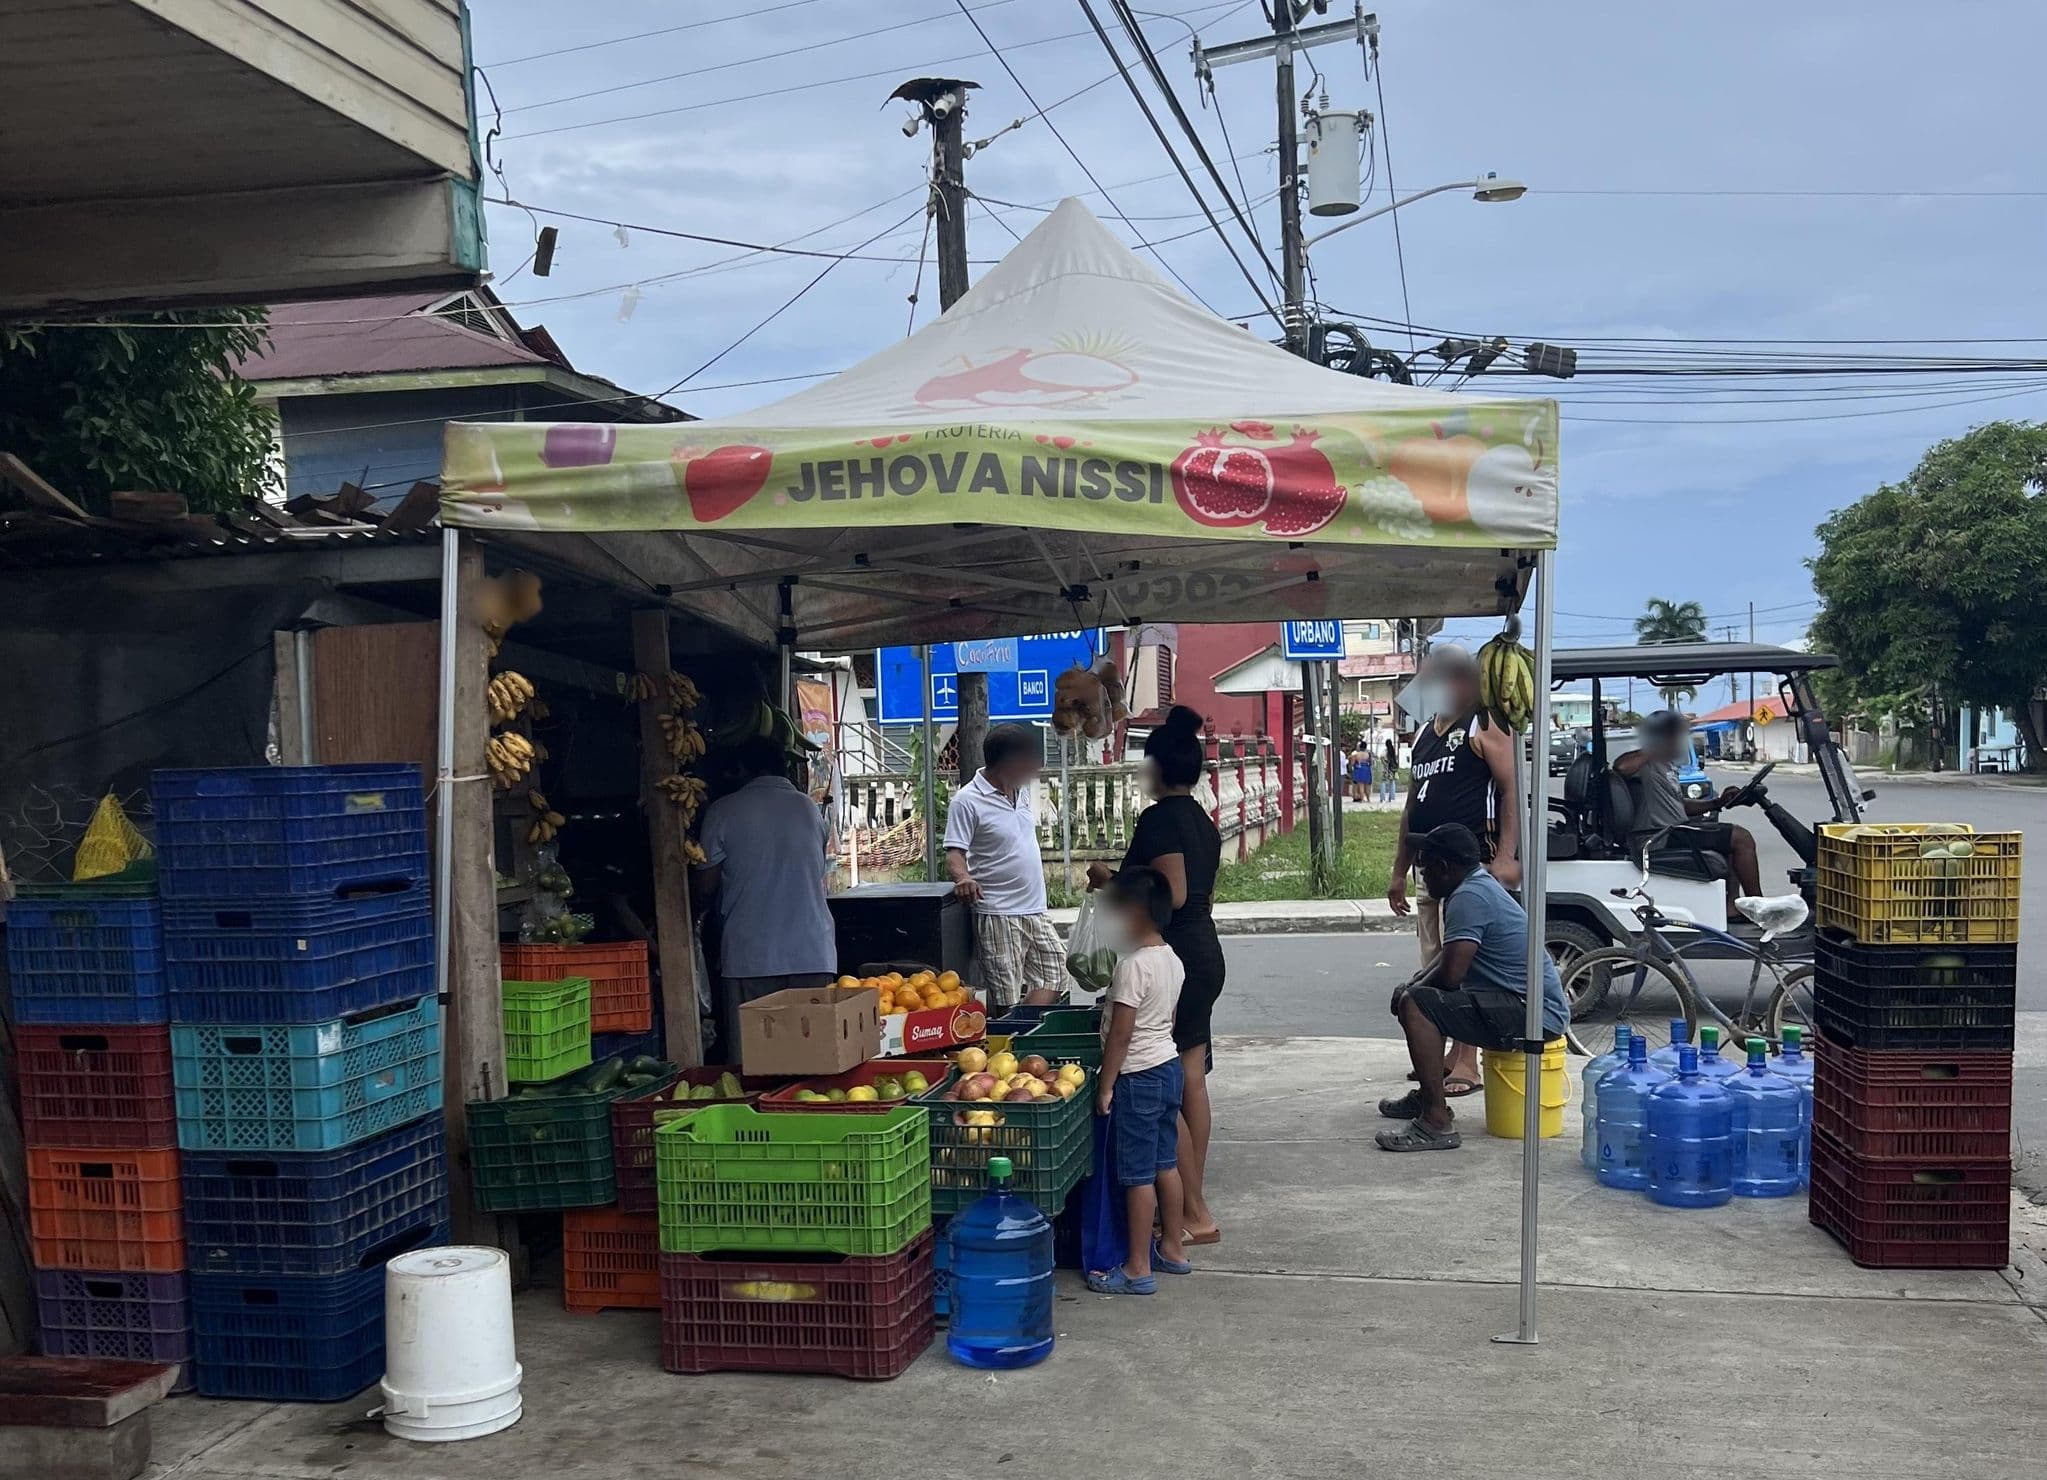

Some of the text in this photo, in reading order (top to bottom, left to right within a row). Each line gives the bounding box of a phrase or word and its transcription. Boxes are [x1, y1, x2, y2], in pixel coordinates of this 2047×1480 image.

[787, 452, 1164, 504] JEHOVA NISSI
[1292, 621, 1335, 643] URBANO
[1023, 681, 1044, 695] BANCO
[1417, 780, 1430, 803] 4
